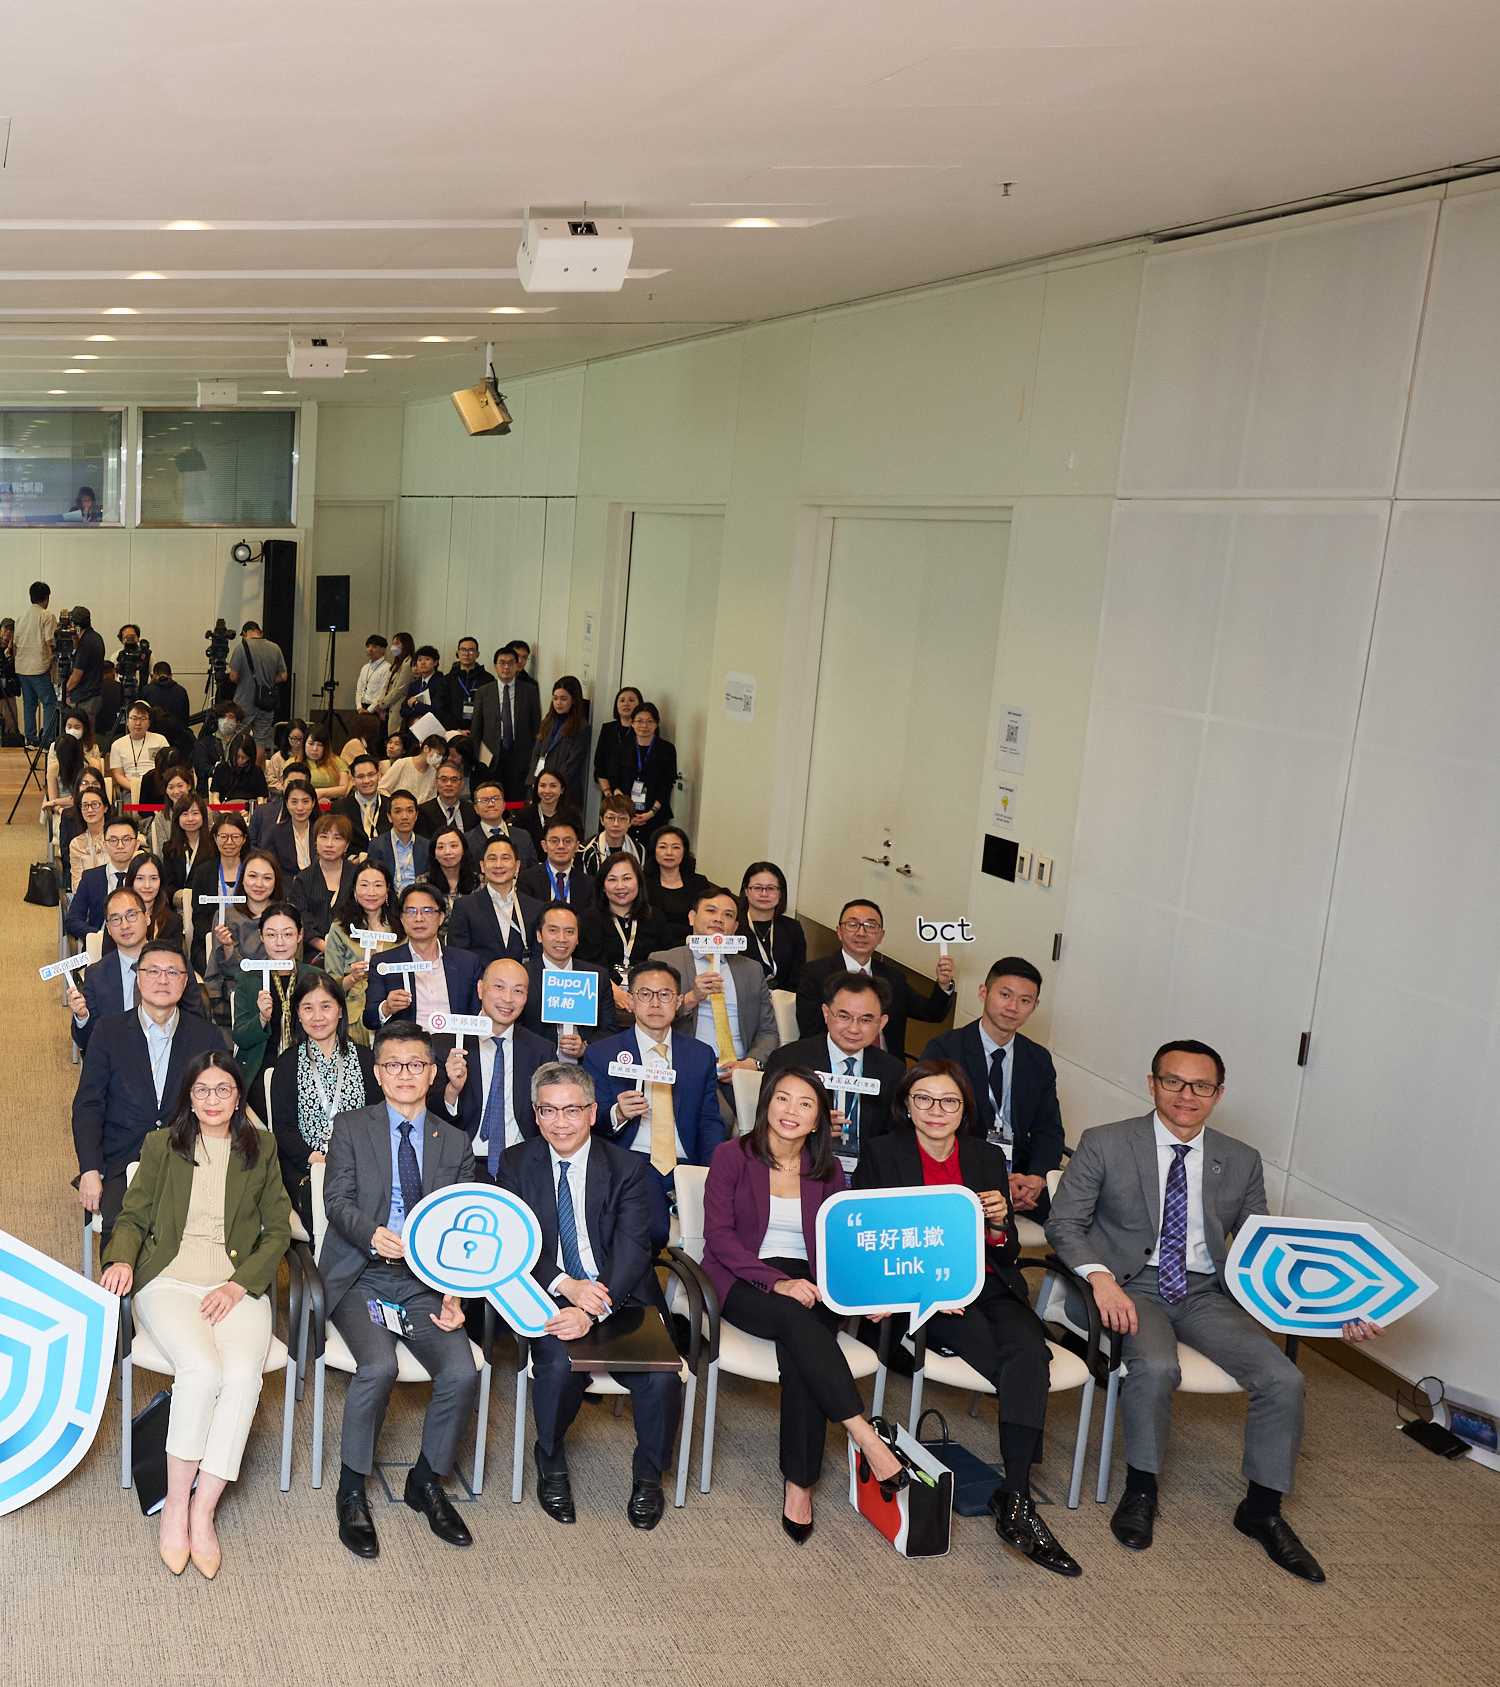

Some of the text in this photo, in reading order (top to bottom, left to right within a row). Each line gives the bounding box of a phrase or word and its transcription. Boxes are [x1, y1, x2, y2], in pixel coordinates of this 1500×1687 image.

[362, 931, 396, 940] CATHAY
[918, 917, 974, 941] bct
[547, 975, 582, 989] Bupa
[547, 995, 575, 1009] 保柏
[884, 1256, 924, 1276] Link
